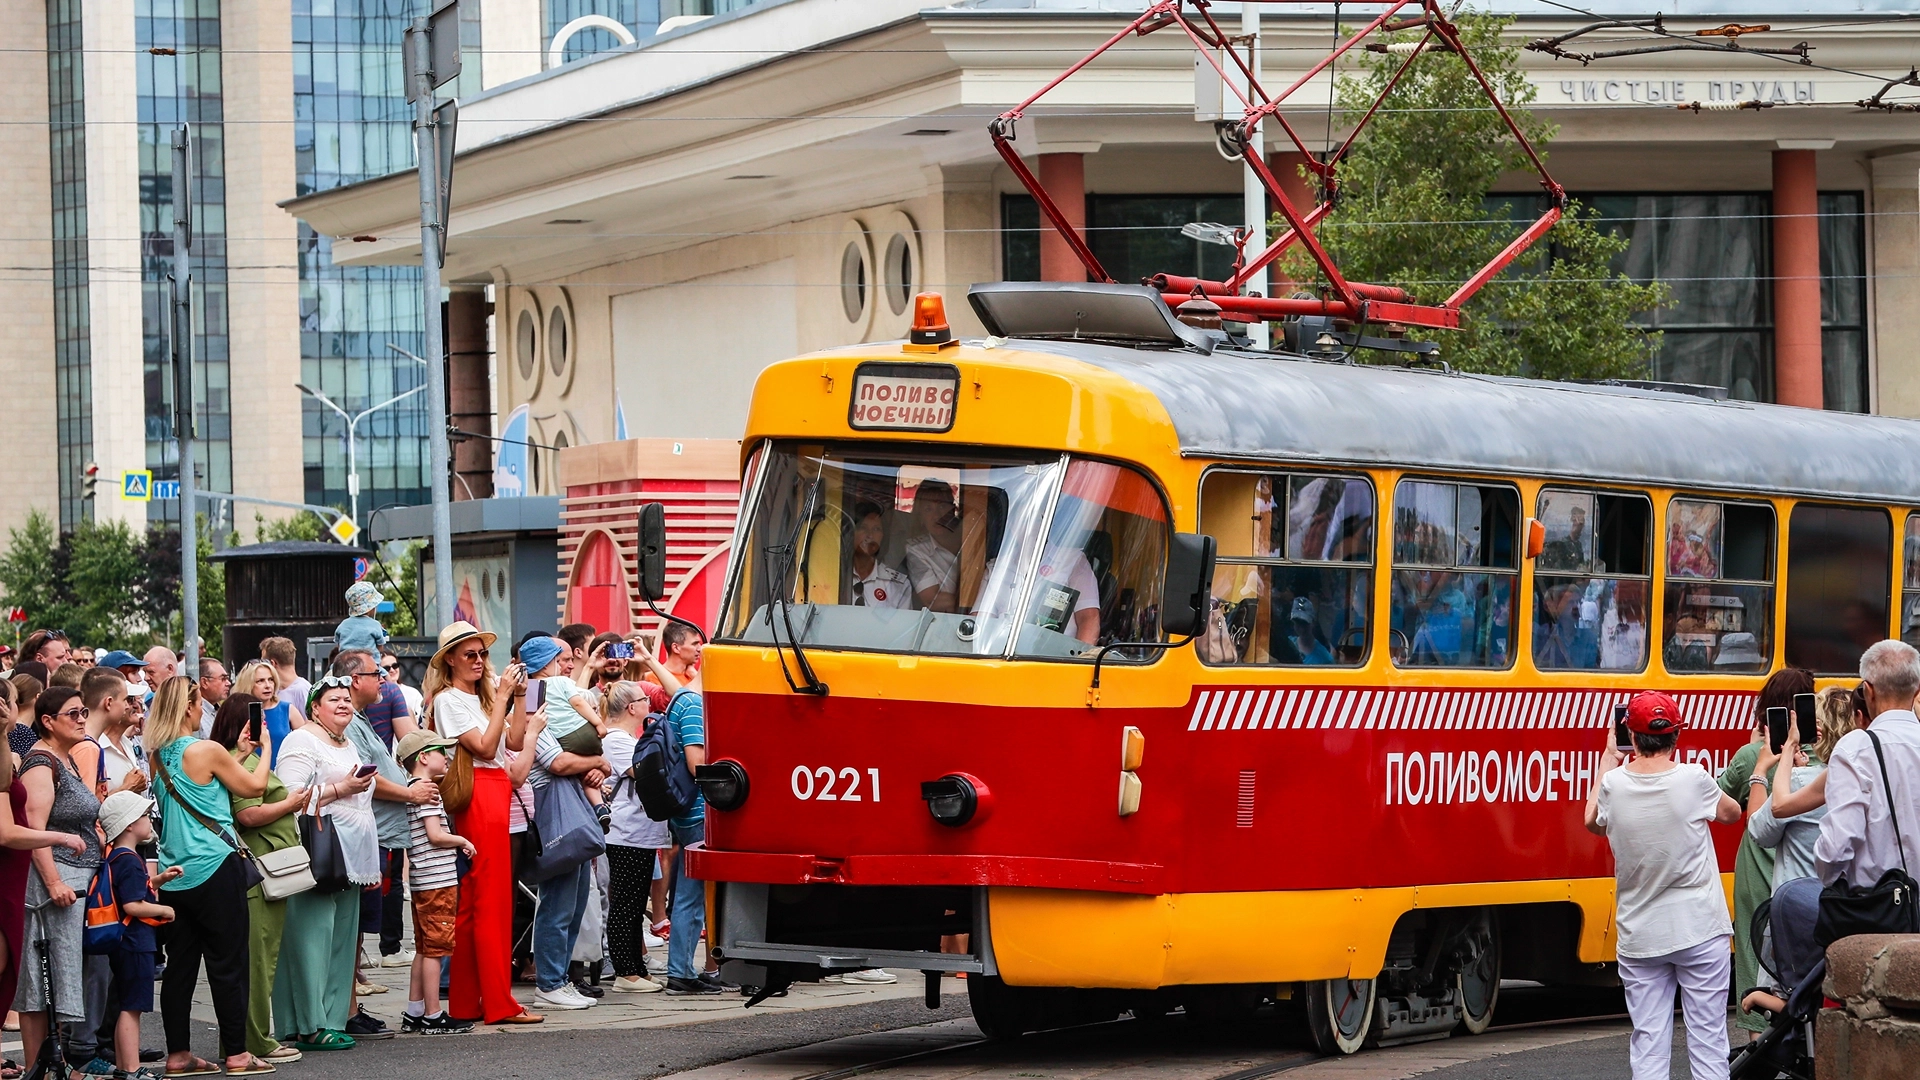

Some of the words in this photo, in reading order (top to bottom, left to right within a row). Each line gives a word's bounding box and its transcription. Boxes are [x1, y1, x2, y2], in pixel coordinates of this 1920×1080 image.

[1560, 79, 1685, 102] ЧИСТЫЕ
[1708, 80, 1816, 103] ПРУДЫ
[860, 383, 954, 405] ПОЛИВО
[791, 764, 881, 802] 0221
[1385, 749, 1630, 806] ПОЛИВОМОЕЧН
